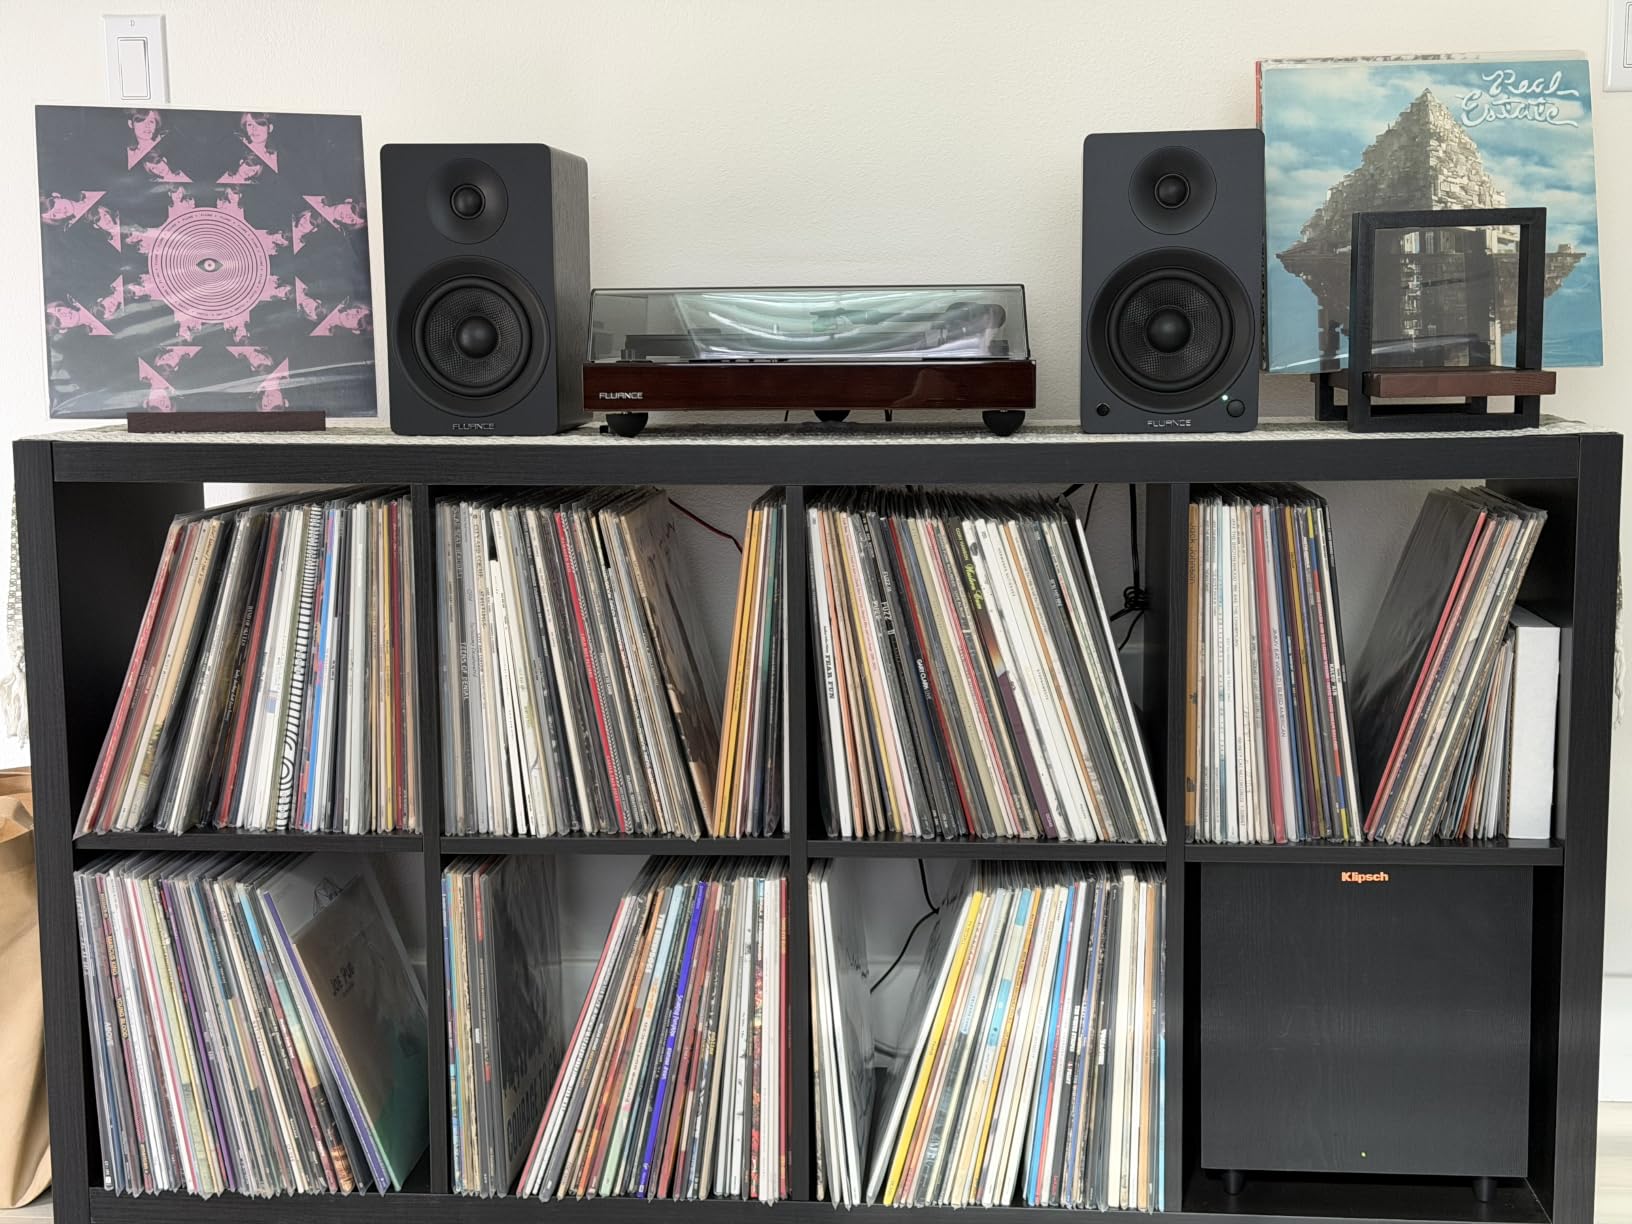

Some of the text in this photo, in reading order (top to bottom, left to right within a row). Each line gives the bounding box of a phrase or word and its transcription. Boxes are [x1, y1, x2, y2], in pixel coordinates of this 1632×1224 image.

[1482, 69, 1579, 97] Real
[1456, 90, 1579, 127] Estate
[1147, 419, 1192, 428] FLUANCE
[1341, 871, 1389, 883] Klipsch
